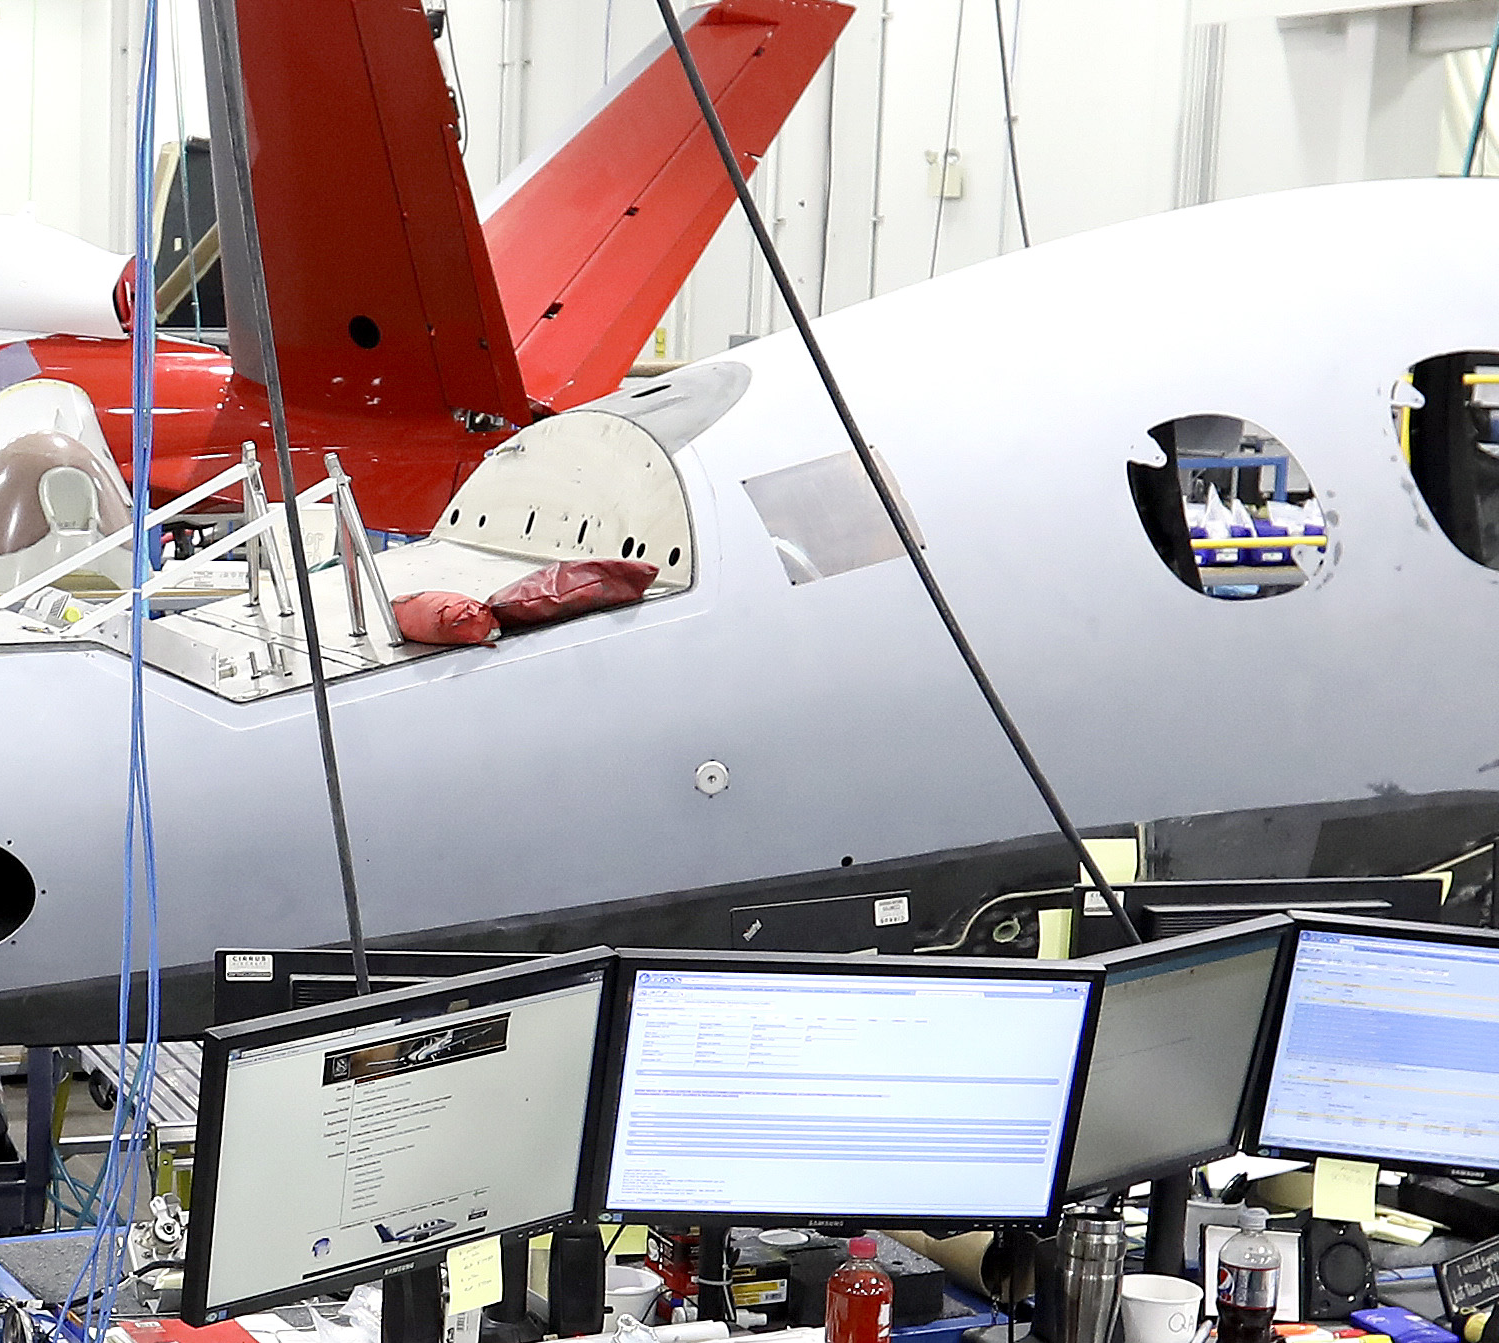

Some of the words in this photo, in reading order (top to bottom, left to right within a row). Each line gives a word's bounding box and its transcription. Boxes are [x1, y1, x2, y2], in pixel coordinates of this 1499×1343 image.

[808, 1219, 845, 1227] SAMSUNG
[383, 1261, 416, 1276] SAMSUNG
[1168, 1312, 1196, 1333] QA
